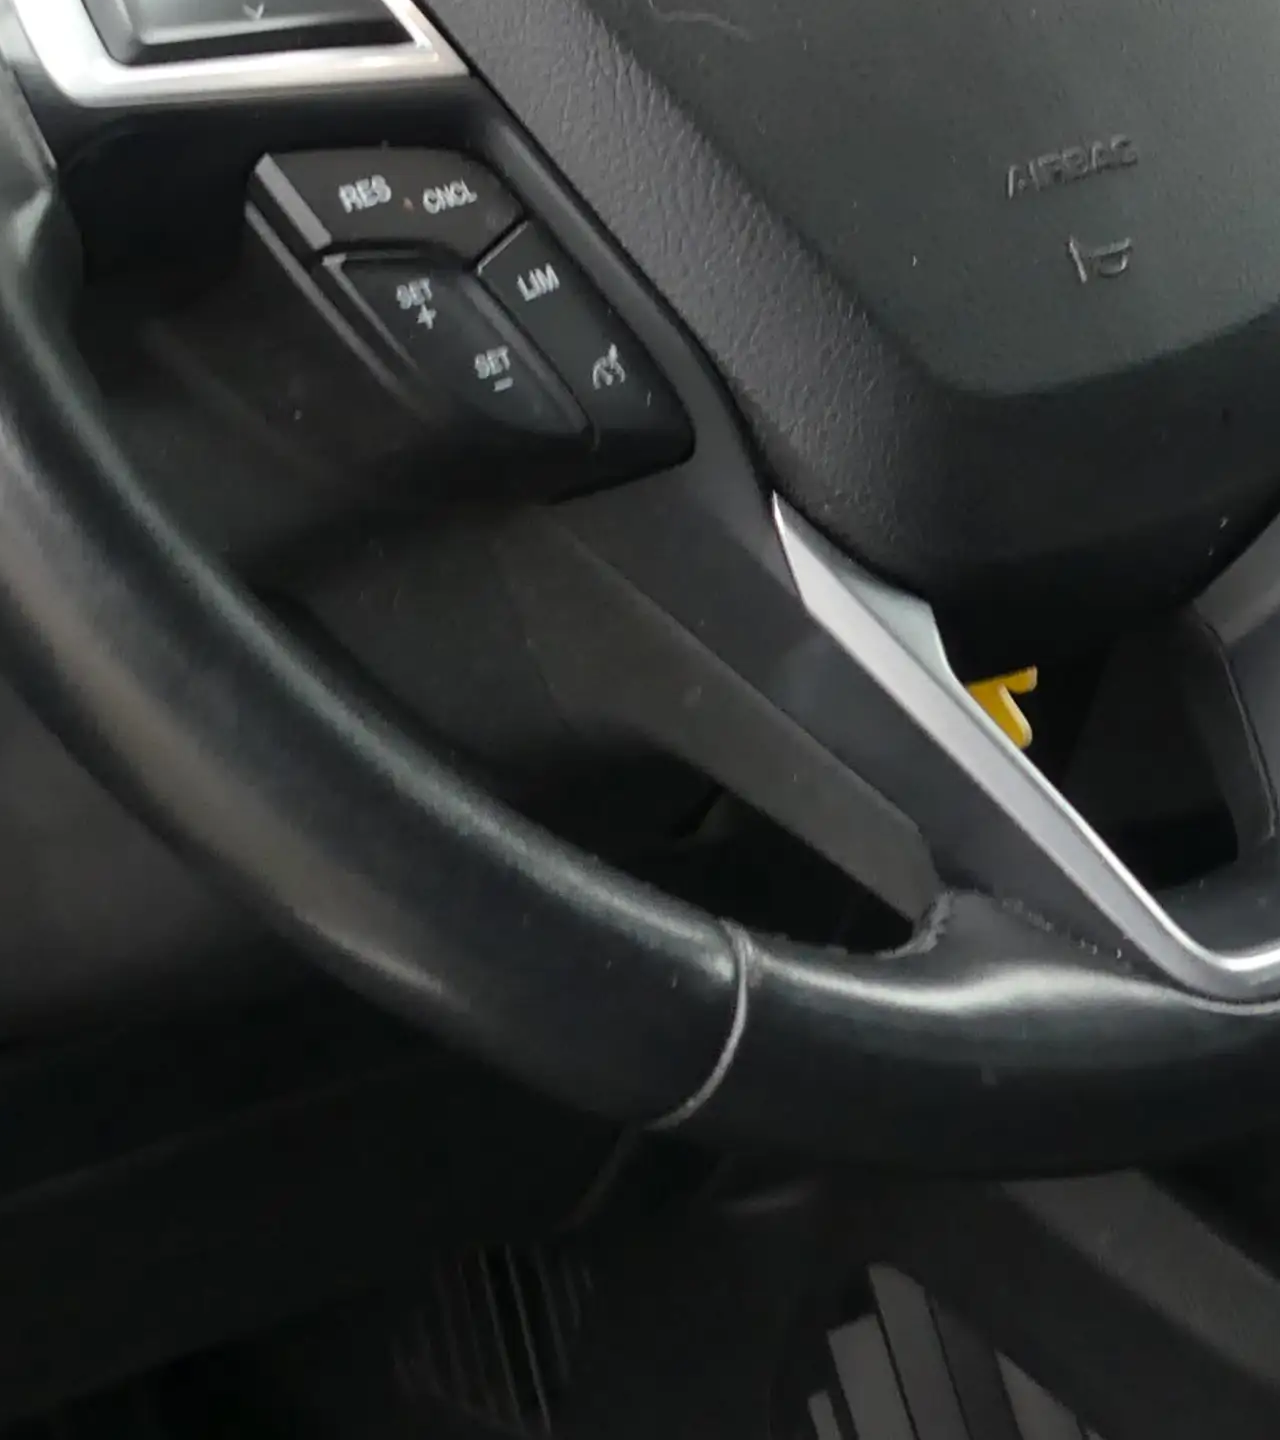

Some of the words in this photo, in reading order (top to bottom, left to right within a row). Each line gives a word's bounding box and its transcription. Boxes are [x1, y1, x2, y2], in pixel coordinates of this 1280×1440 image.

[1004, 133, 1139, 200] AIRBAG
[339, 173, 392, 214] RES
[422, 176, 478, 215] CNCL
[396, 277, 433, 310] SET
[517, 262, 560, 302] LIM
[473, 344, 512, 380] SET
